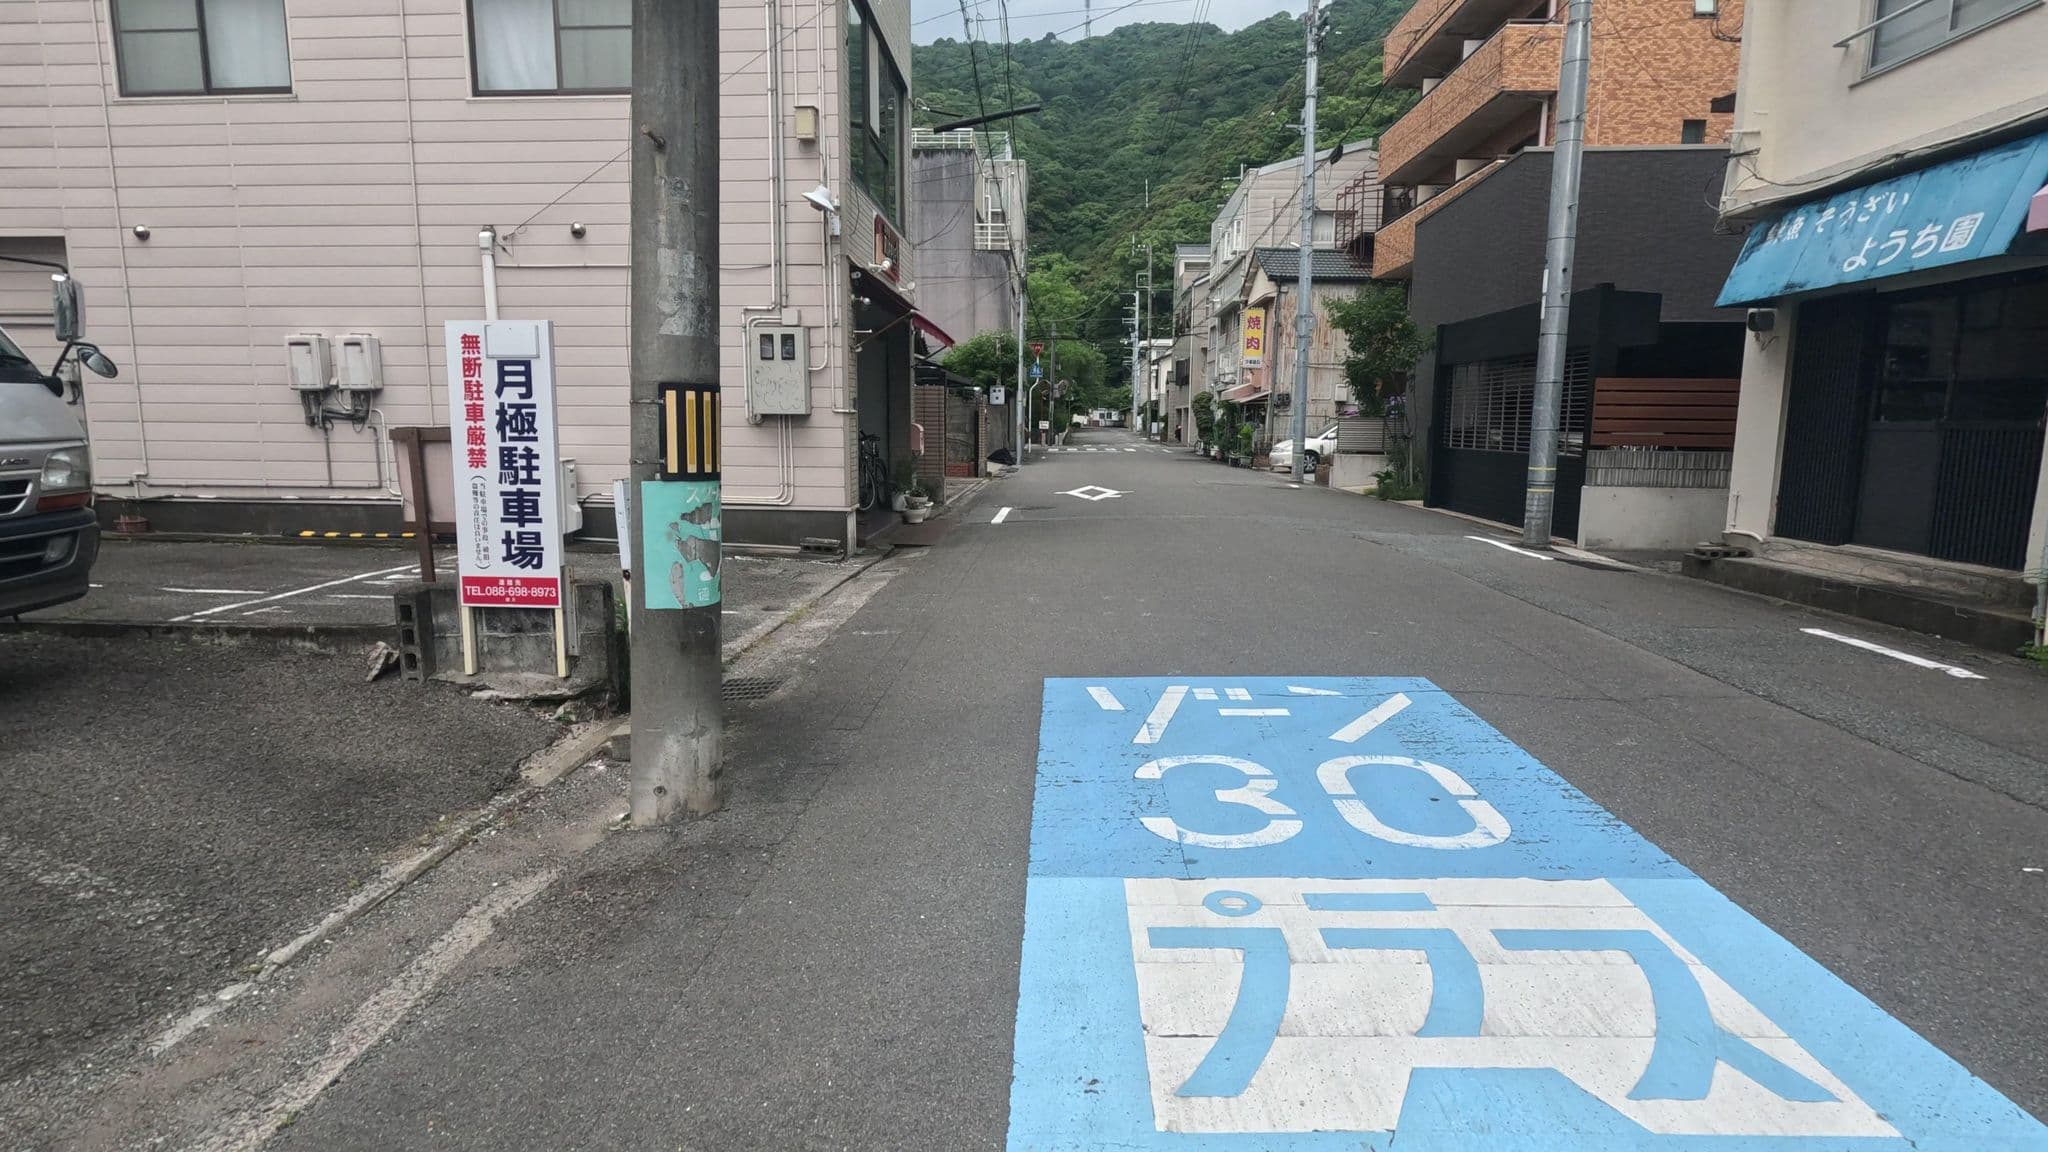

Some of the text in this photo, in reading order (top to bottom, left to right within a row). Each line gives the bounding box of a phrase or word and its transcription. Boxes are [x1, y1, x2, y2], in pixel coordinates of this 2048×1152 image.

[1816, 191, 1909, 233] そうざい
[1842, 211, 1985, 273] ようち園
[1246, 316, 1261, 350] 焼肉
[461, 333, 487, 469] 無断駐車厳禁
[494, 359, 545, 570] 月極駐車場
[1087, 683, 1414, 745] ゾーン
[1133, 754, 1512, 850] 30
[1147, 889, 1842, 1105] プラス
